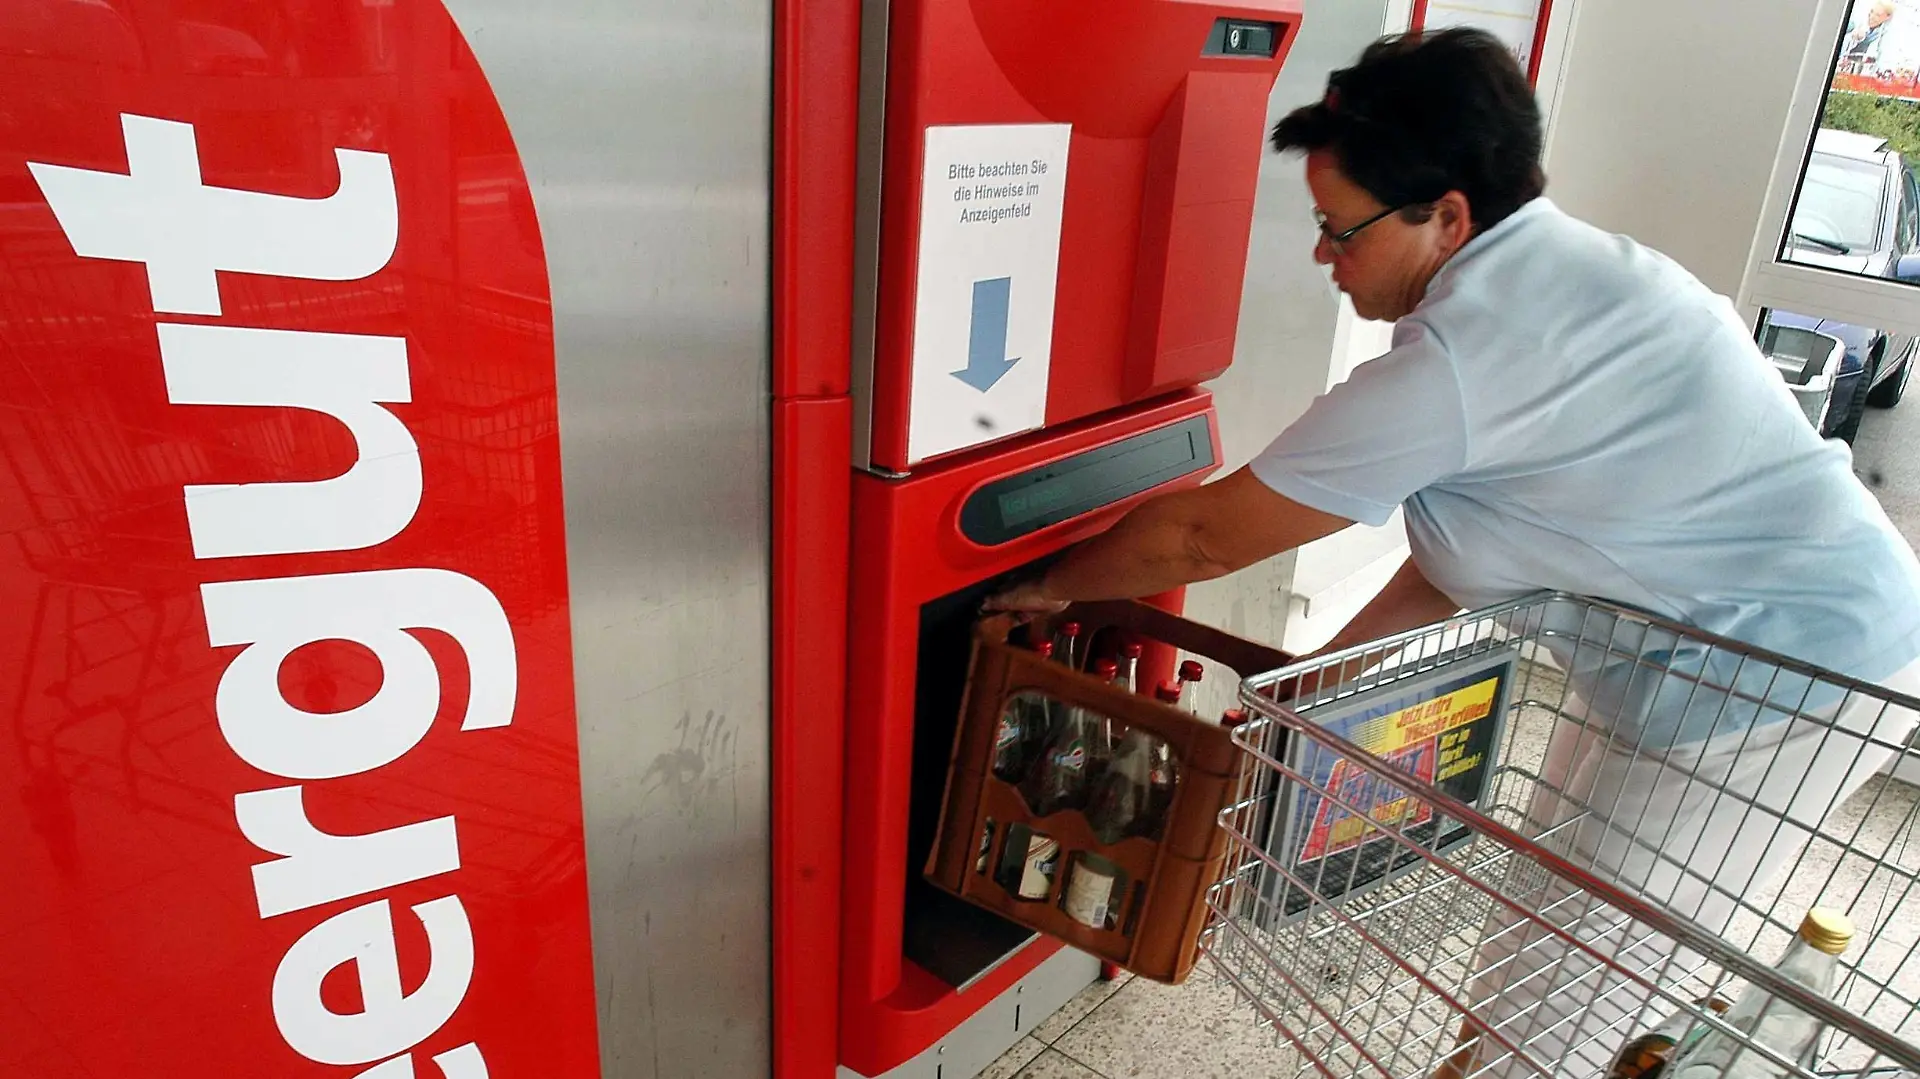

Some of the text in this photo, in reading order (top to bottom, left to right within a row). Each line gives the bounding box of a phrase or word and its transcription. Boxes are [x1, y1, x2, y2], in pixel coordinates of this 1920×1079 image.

[948, 159, 1048, 179] Bitte beachten Sie
[953, 182, 1039, 201] die Hinweise im
[960, 202, 1031, 223] Anzeigenfeld
